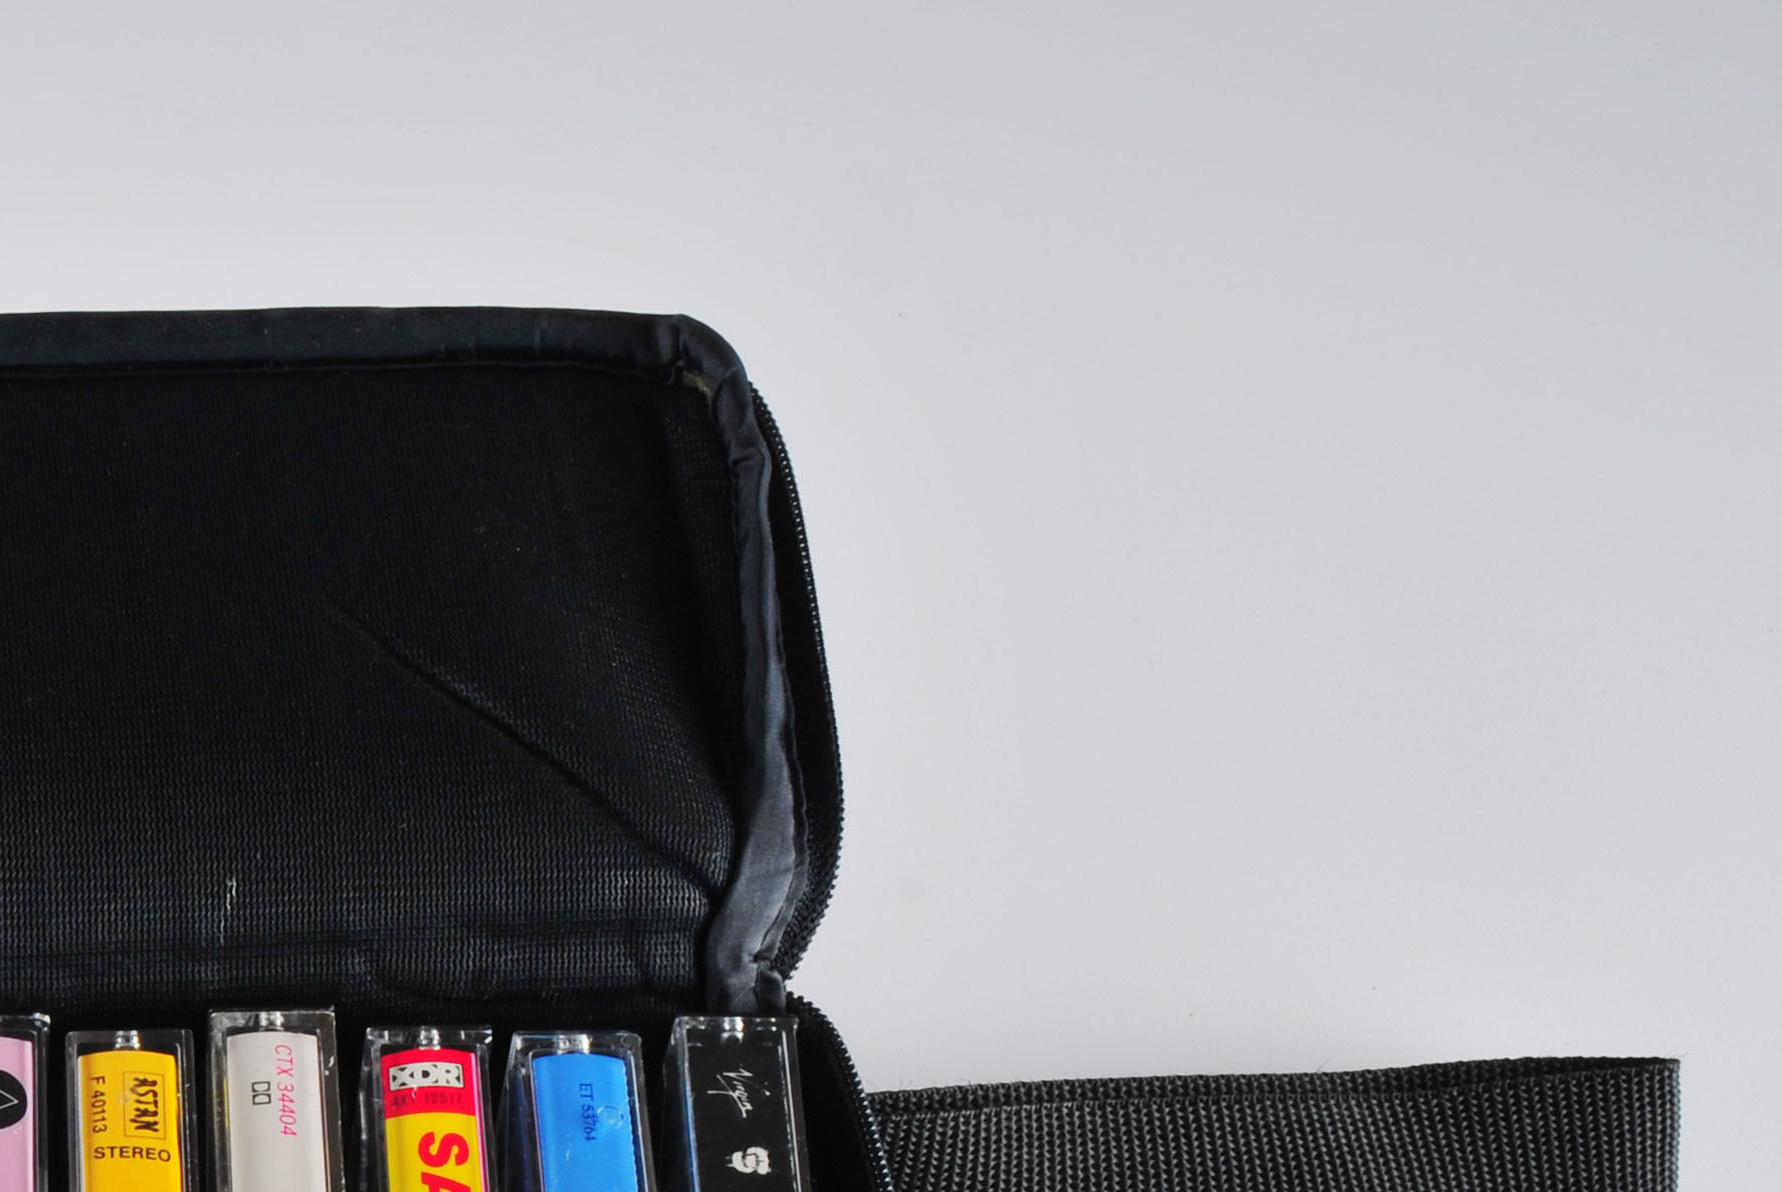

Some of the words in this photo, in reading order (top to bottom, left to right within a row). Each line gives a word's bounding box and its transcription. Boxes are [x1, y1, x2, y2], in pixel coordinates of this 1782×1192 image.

[274, 1044, 294, 1076] CTX
[91, 1075, 105, 1086] F
[389, 1062, 464, 1091] XDR
[579, 1083, 593, 1101] ET
[90, 1091, 108, 1134] 40113
[129, 1076, 159, 1133] ASTAN
[277, 1081, 298, 1136] 34404
[580, 1105, 597, 1141] 53764
[93, 1146, 171, 1162] STEREO
